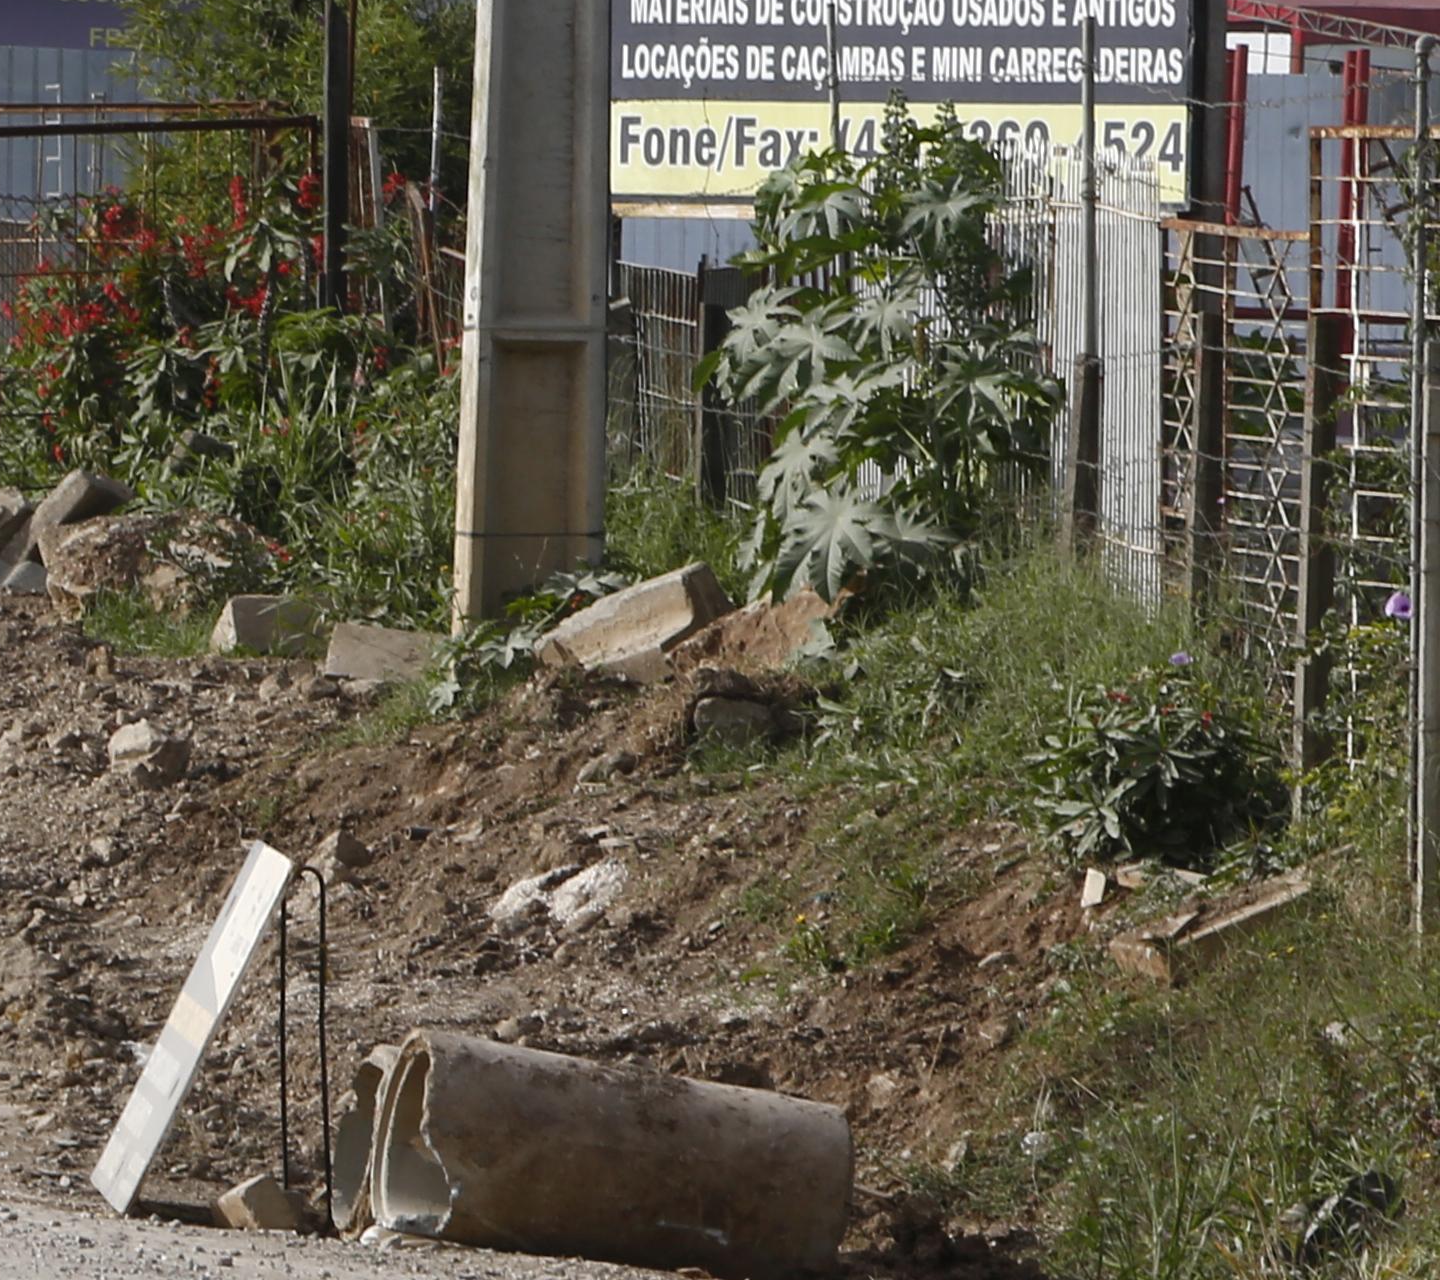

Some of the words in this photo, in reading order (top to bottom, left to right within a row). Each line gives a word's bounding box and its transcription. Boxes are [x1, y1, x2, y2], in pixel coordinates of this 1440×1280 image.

[622, 36, 739, 89] LOCAÇÕES
[746, 45, 775, 81] DE
[911, 47, 926, 82] E
[932, 47, 982, 82] MINI
[989, 48, 1183, 84] CARREGDEIRAS
[619, 115, 819, 173] Fone/Fax:
